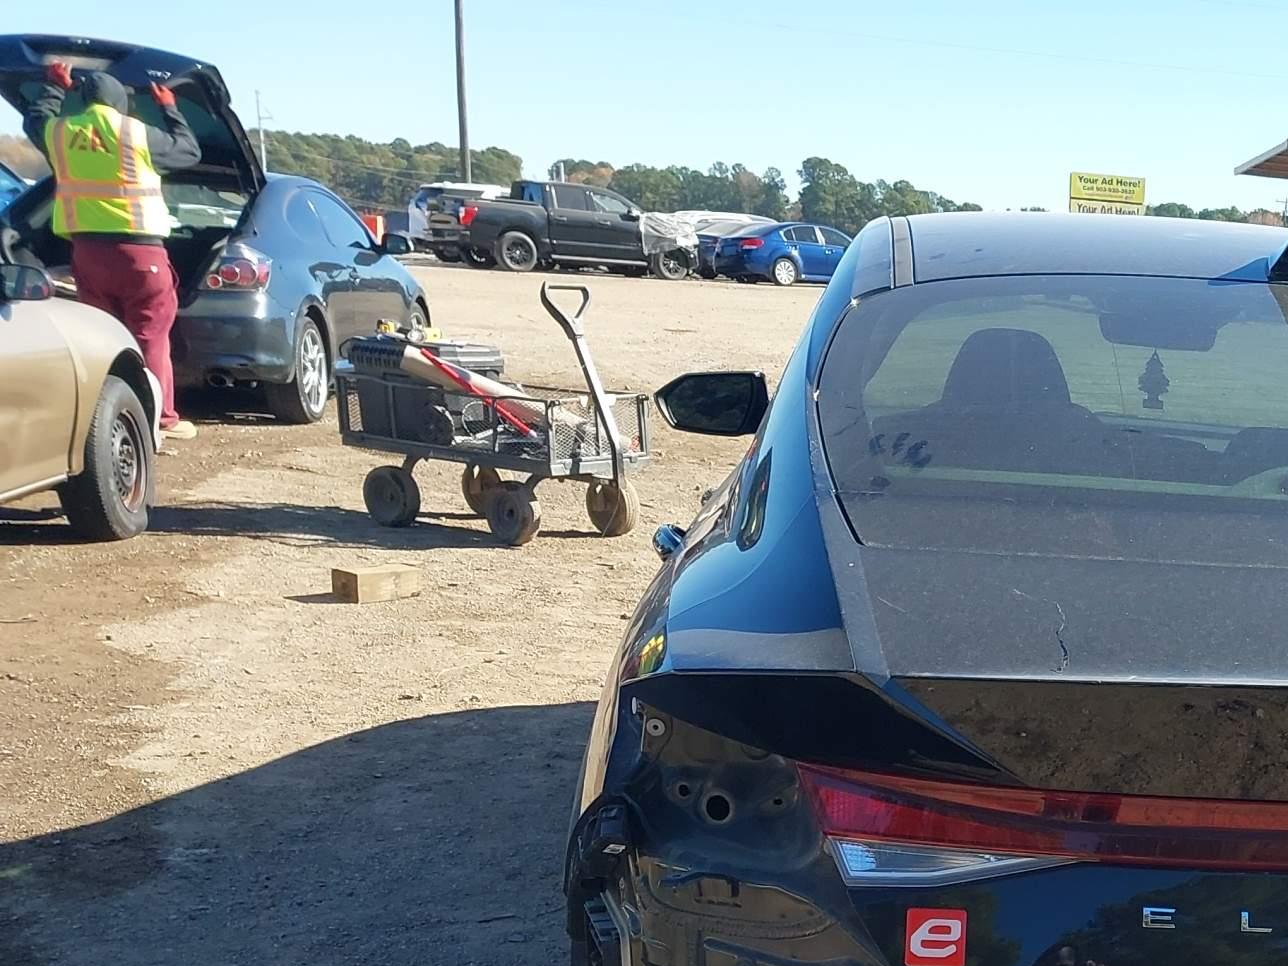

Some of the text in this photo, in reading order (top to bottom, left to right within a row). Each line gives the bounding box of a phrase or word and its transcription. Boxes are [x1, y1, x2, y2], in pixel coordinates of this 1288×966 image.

[1078, 176, 1141, 188] Your Ad Here!
